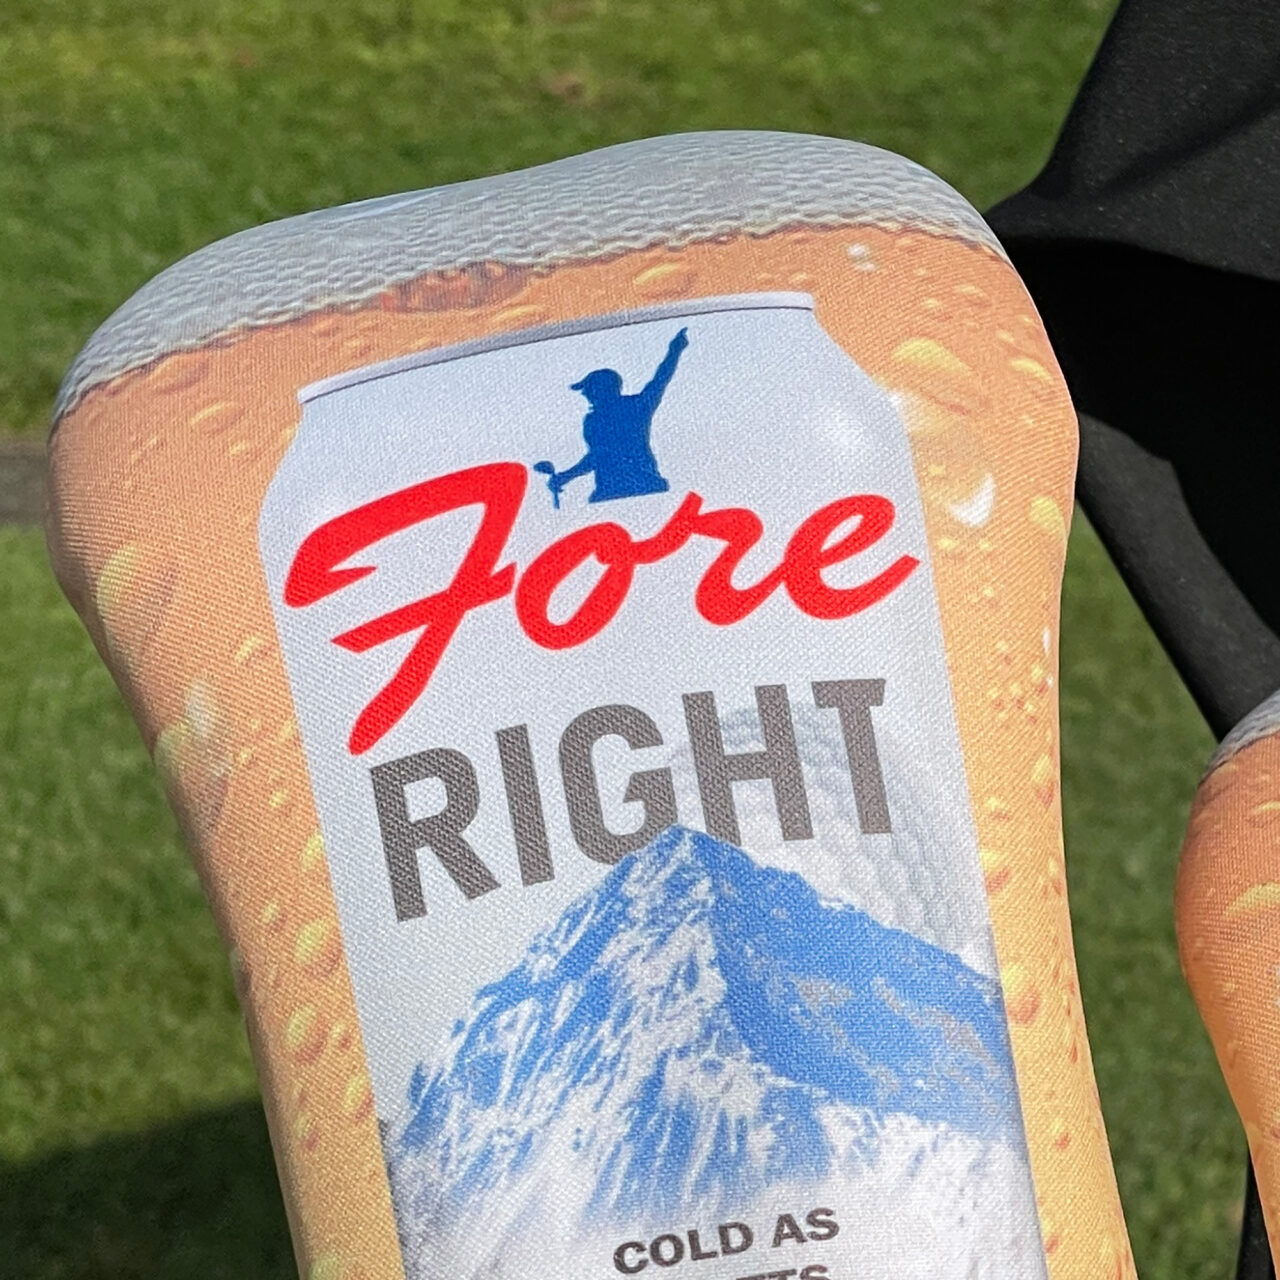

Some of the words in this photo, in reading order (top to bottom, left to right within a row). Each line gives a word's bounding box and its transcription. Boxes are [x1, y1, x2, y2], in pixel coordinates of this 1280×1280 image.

[285, 462, 920, 756] Fore
[369, 677, 896, 923] RIGHT
[612, 1221, 755, 1275] COLD
[771, 1207, 841, 1250] AS
